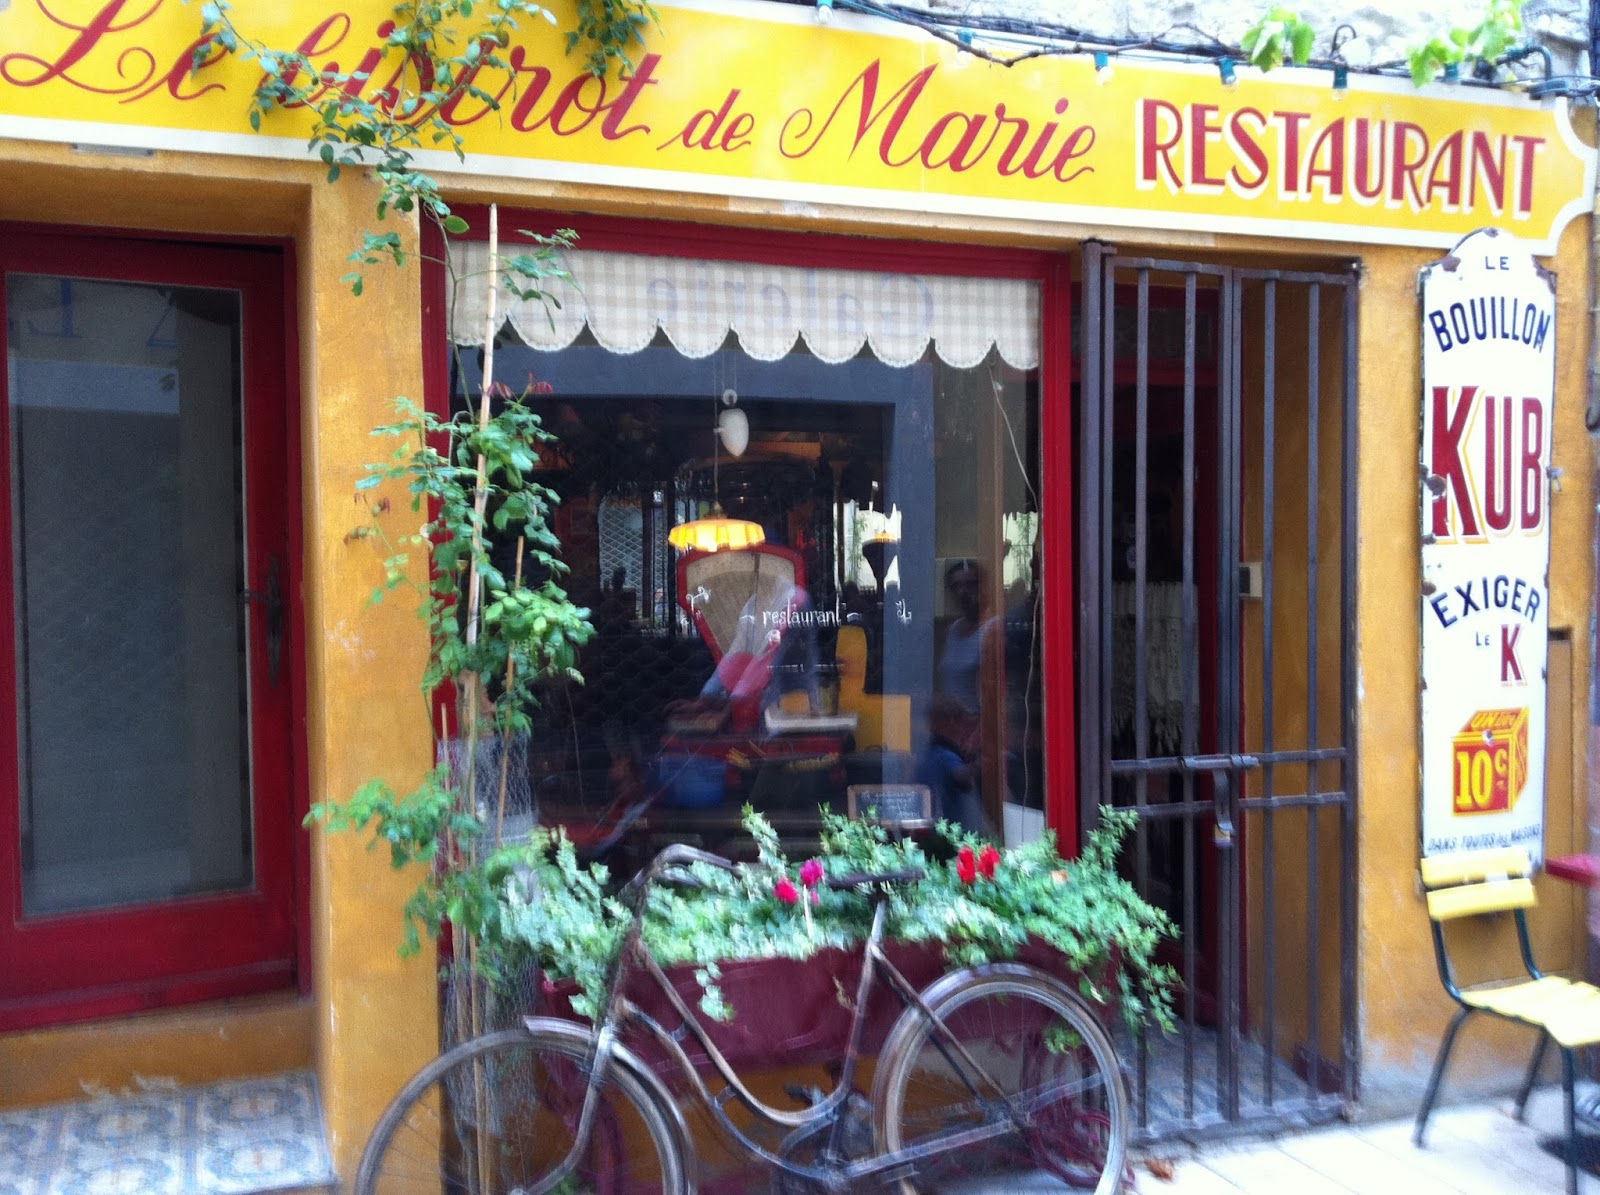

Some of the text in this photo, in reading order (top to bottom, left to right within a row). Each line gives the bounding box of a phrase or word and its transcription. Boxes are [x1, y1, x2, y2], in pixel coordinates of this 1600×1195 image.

[0, 0, 226, 103] Le
[657, 88, 755, 151] de
[778, 57, 1097, 183] Marie
[1137, 98, 1547, 217] RESTAURANT
[1484, 255, 1511, 271] LE
[1428, 295, 1551, 353] BOUILLON
[1431, 385, 1545, 538] KUB
[763, 594, 842, 627] restaurant
[1429, 574, 1541, 629] EXIGER
[1500, 623, 1523, 683] K
